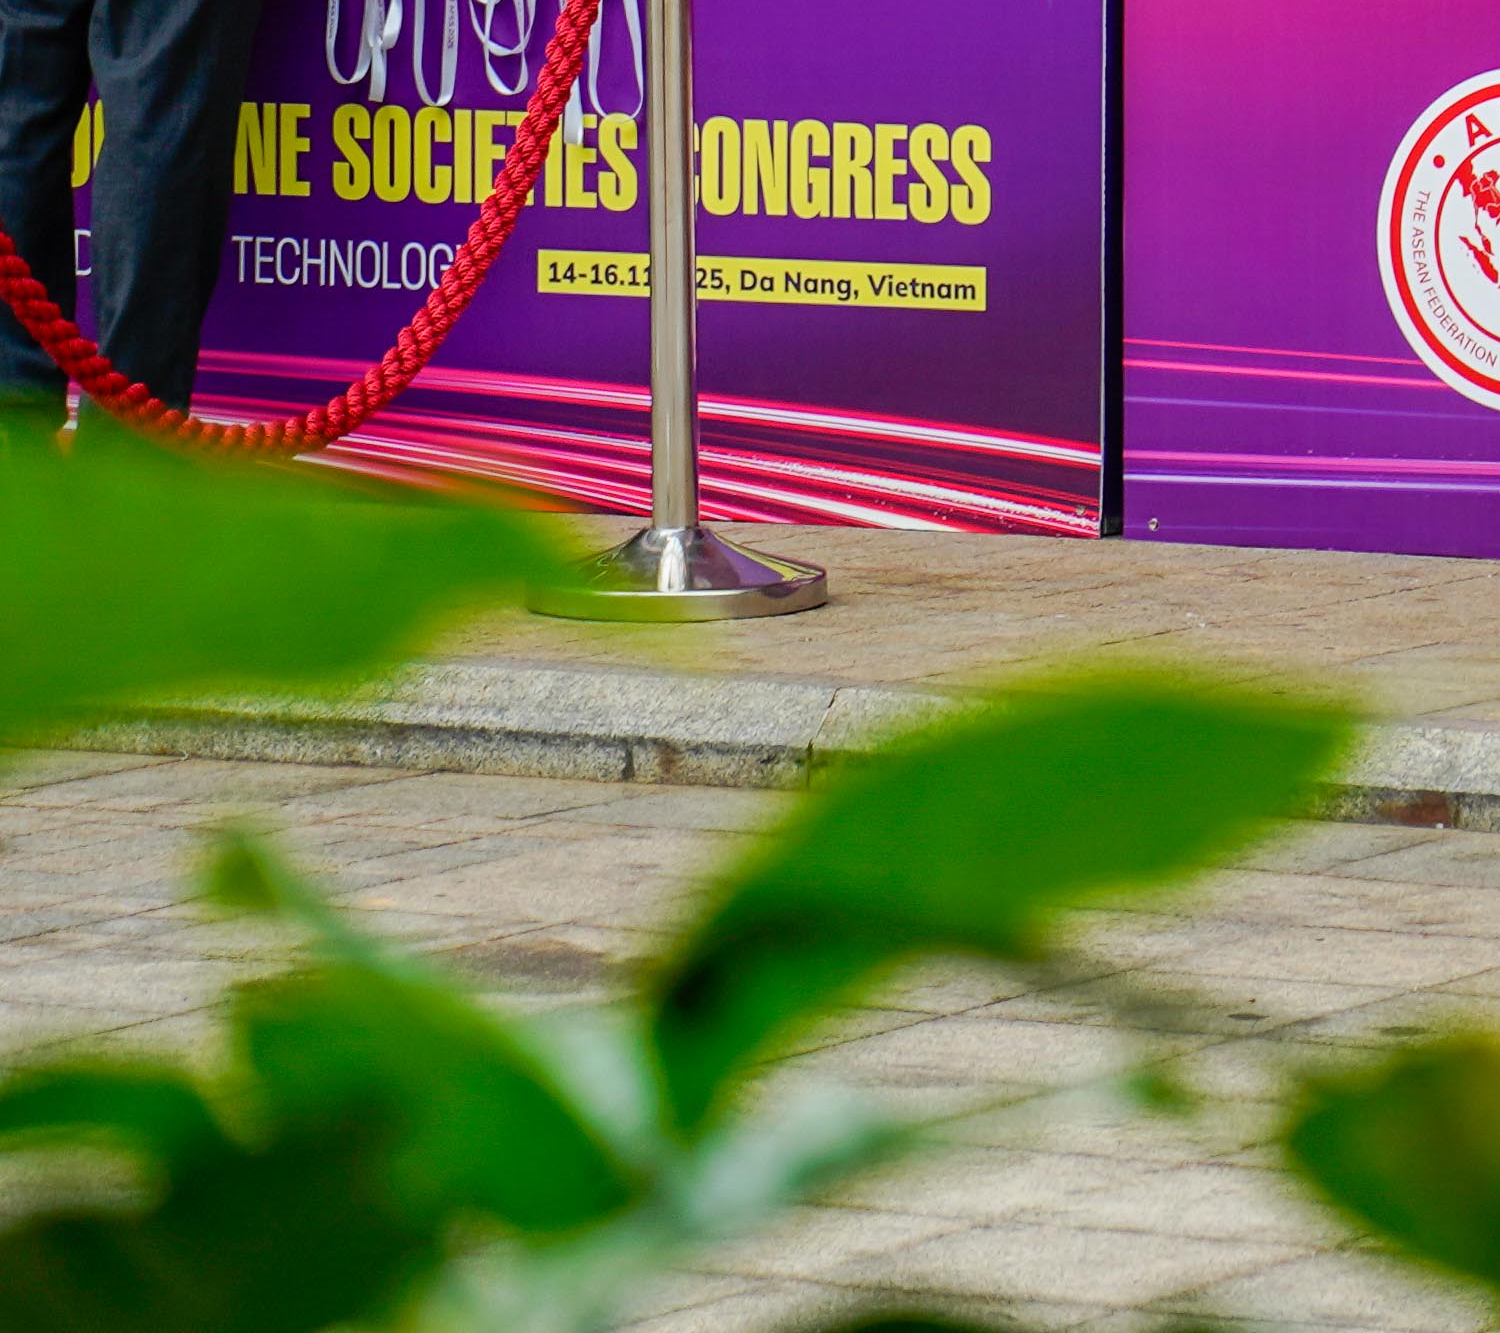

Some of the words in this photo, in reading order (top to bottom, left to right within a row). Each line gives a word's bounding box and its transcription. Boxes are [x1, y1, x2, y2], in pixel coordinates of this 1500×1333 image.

[694, 116, 991, 226] ONGRESS
[1413, 190, 1431, 223] THE
[231, 235, 460, 290] TECHNOLOG
[1411, 226, 1433, 284] ASEAN
[740, 270, 775, 293] Da
[784, 272, 860, 301] Nang,
[868, 274, 977, 302] Vietnam
[1424, 286, 1498, 367] FEDERATION
